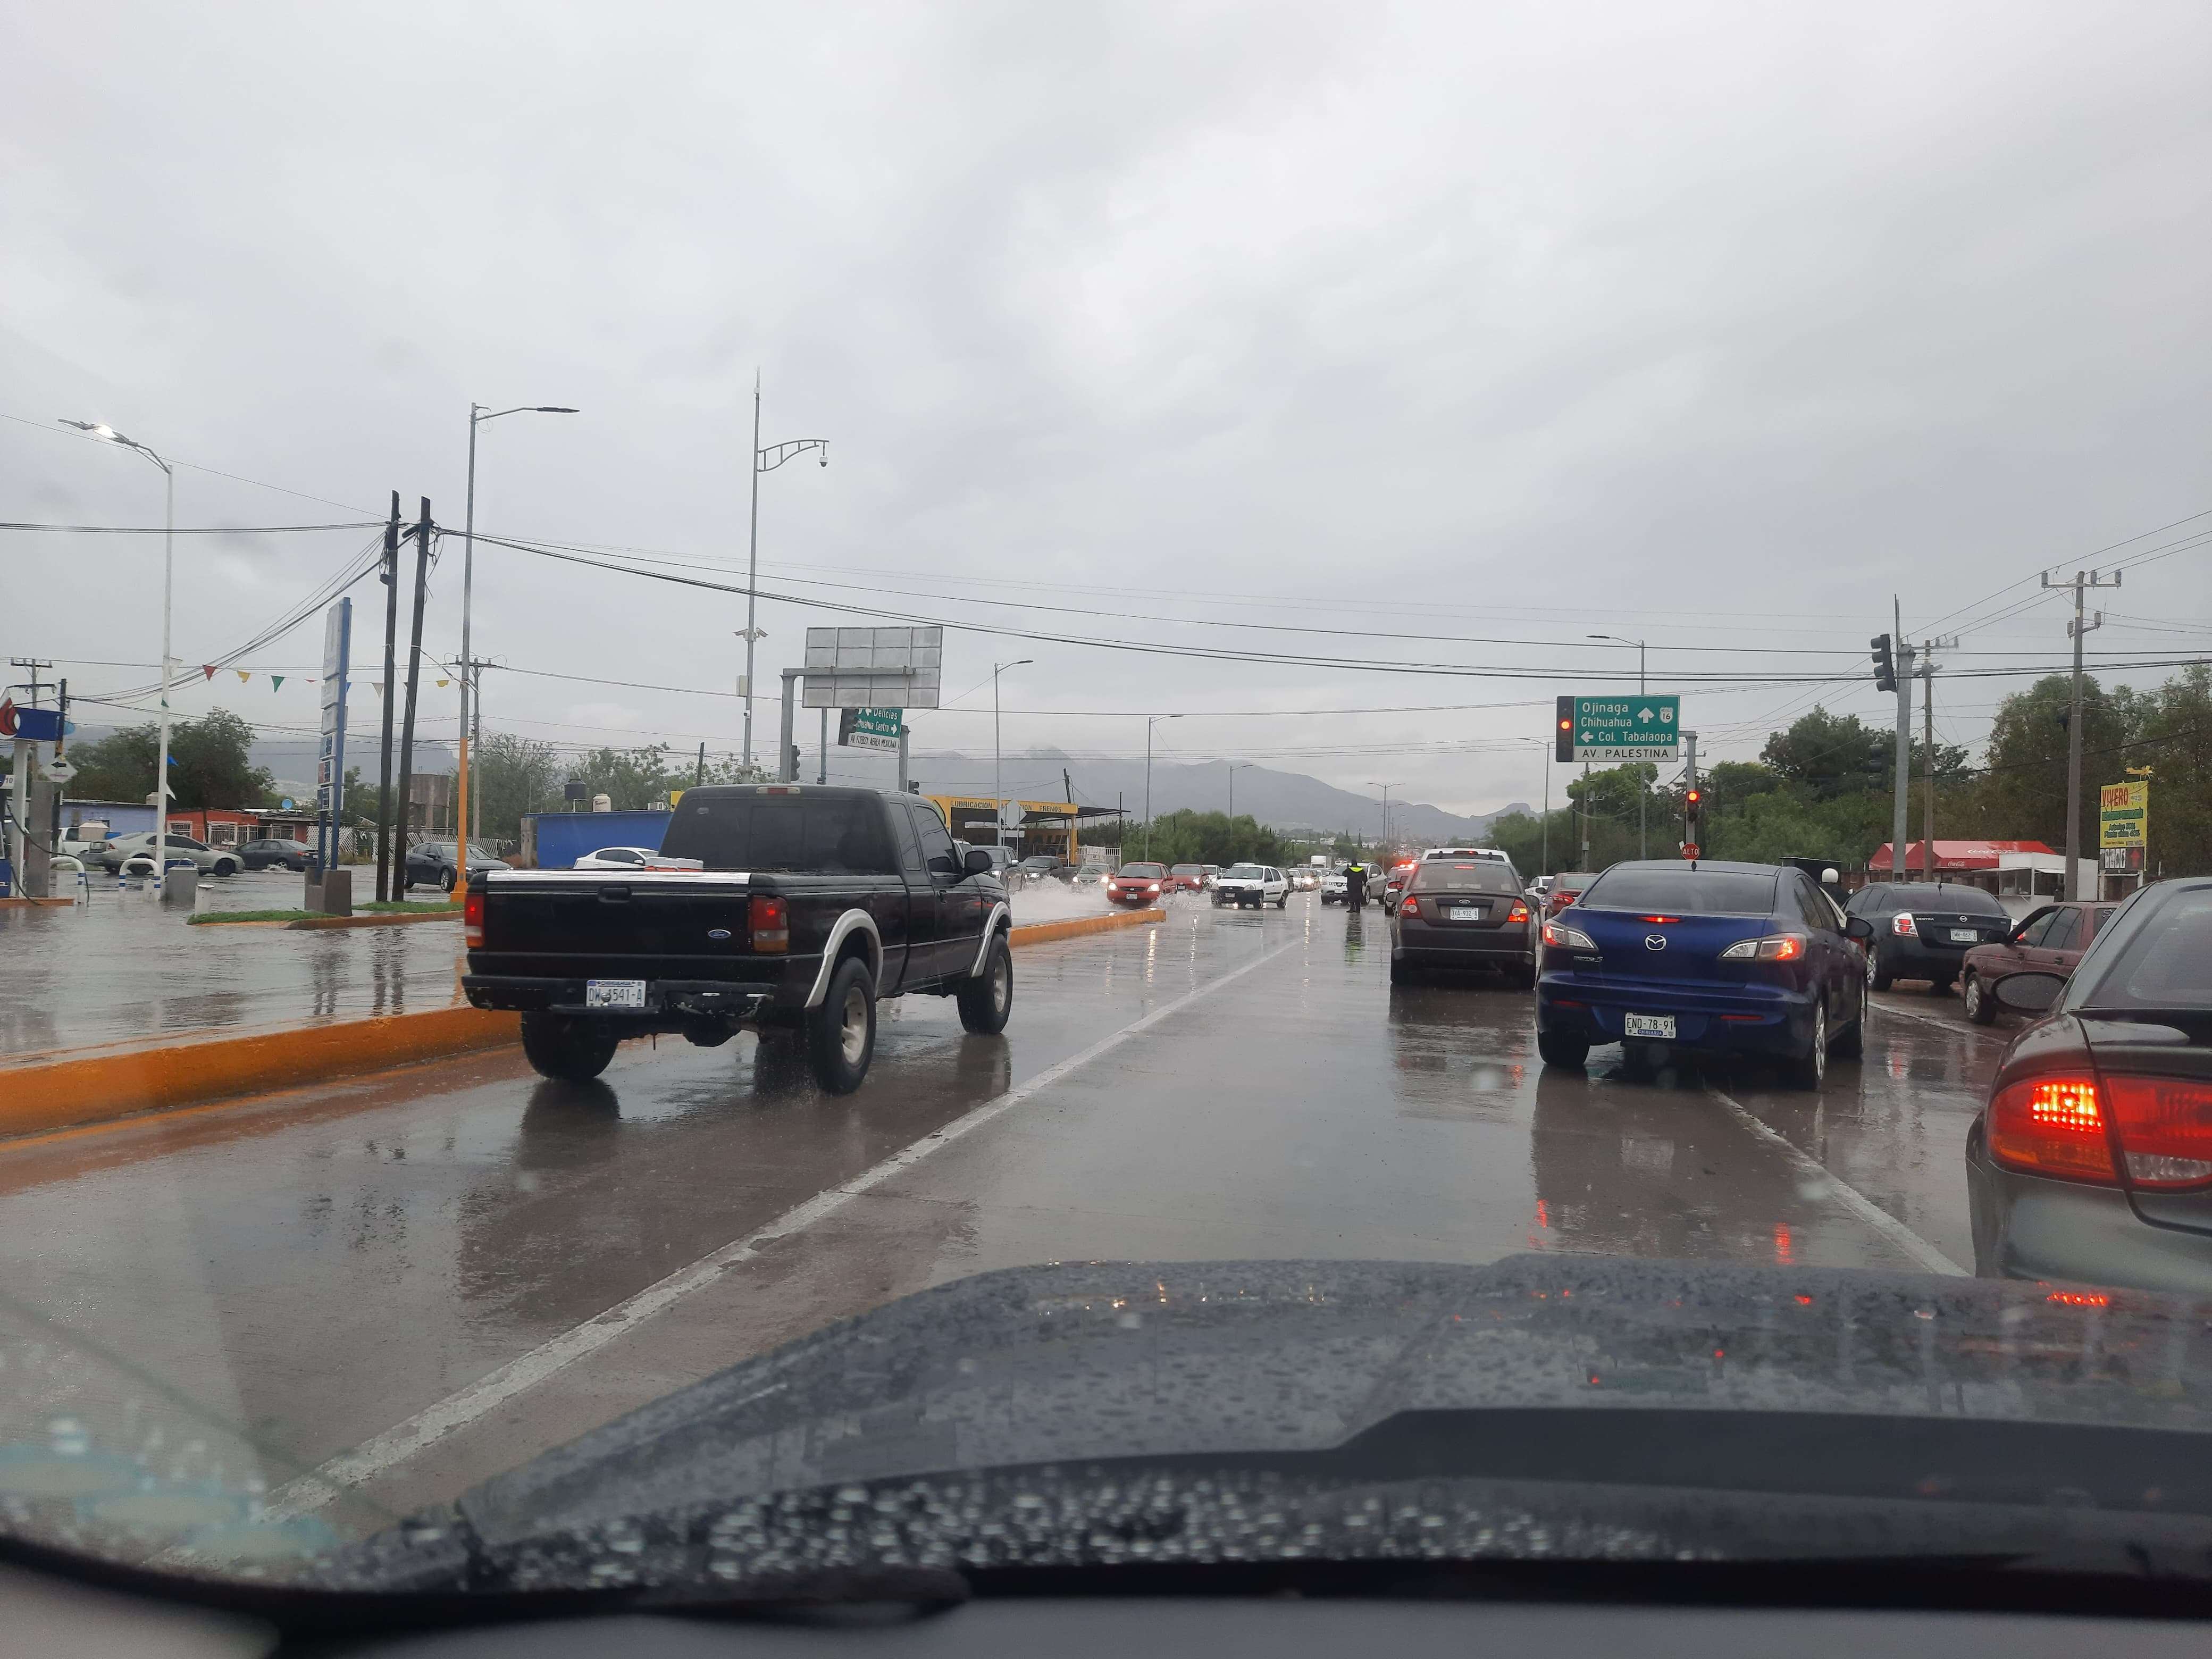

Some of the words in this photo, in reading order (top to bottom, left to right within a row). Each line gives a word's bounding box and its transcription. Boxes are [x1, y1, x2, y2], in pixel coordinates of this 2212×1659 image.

[874, 708, 898, 720] Delicias
[1582, 702, 1628, 715] Ojinaga
[875, 721, 889, 732] Centro
[1581, 717, 1632, 727] Chihuahua
[857, 735, 869, 745] FUERZA
[870, 738, 880, 747] AEREA
[882, 740, 896, 749] MEXICANA
[1598, 731, 1616, 742] Col.
[1622, 731, 1672, 743] Tabalaopa
[1582, 749, 1599, 758] AV.
[1605, 749, 1669, 758] PALESTINA
[2102, 787, 2129, 807] VIVERO
[951, 800, 993, 809] LUBRICACION
[1627, 1017, 1673, 1030] END-78-91
